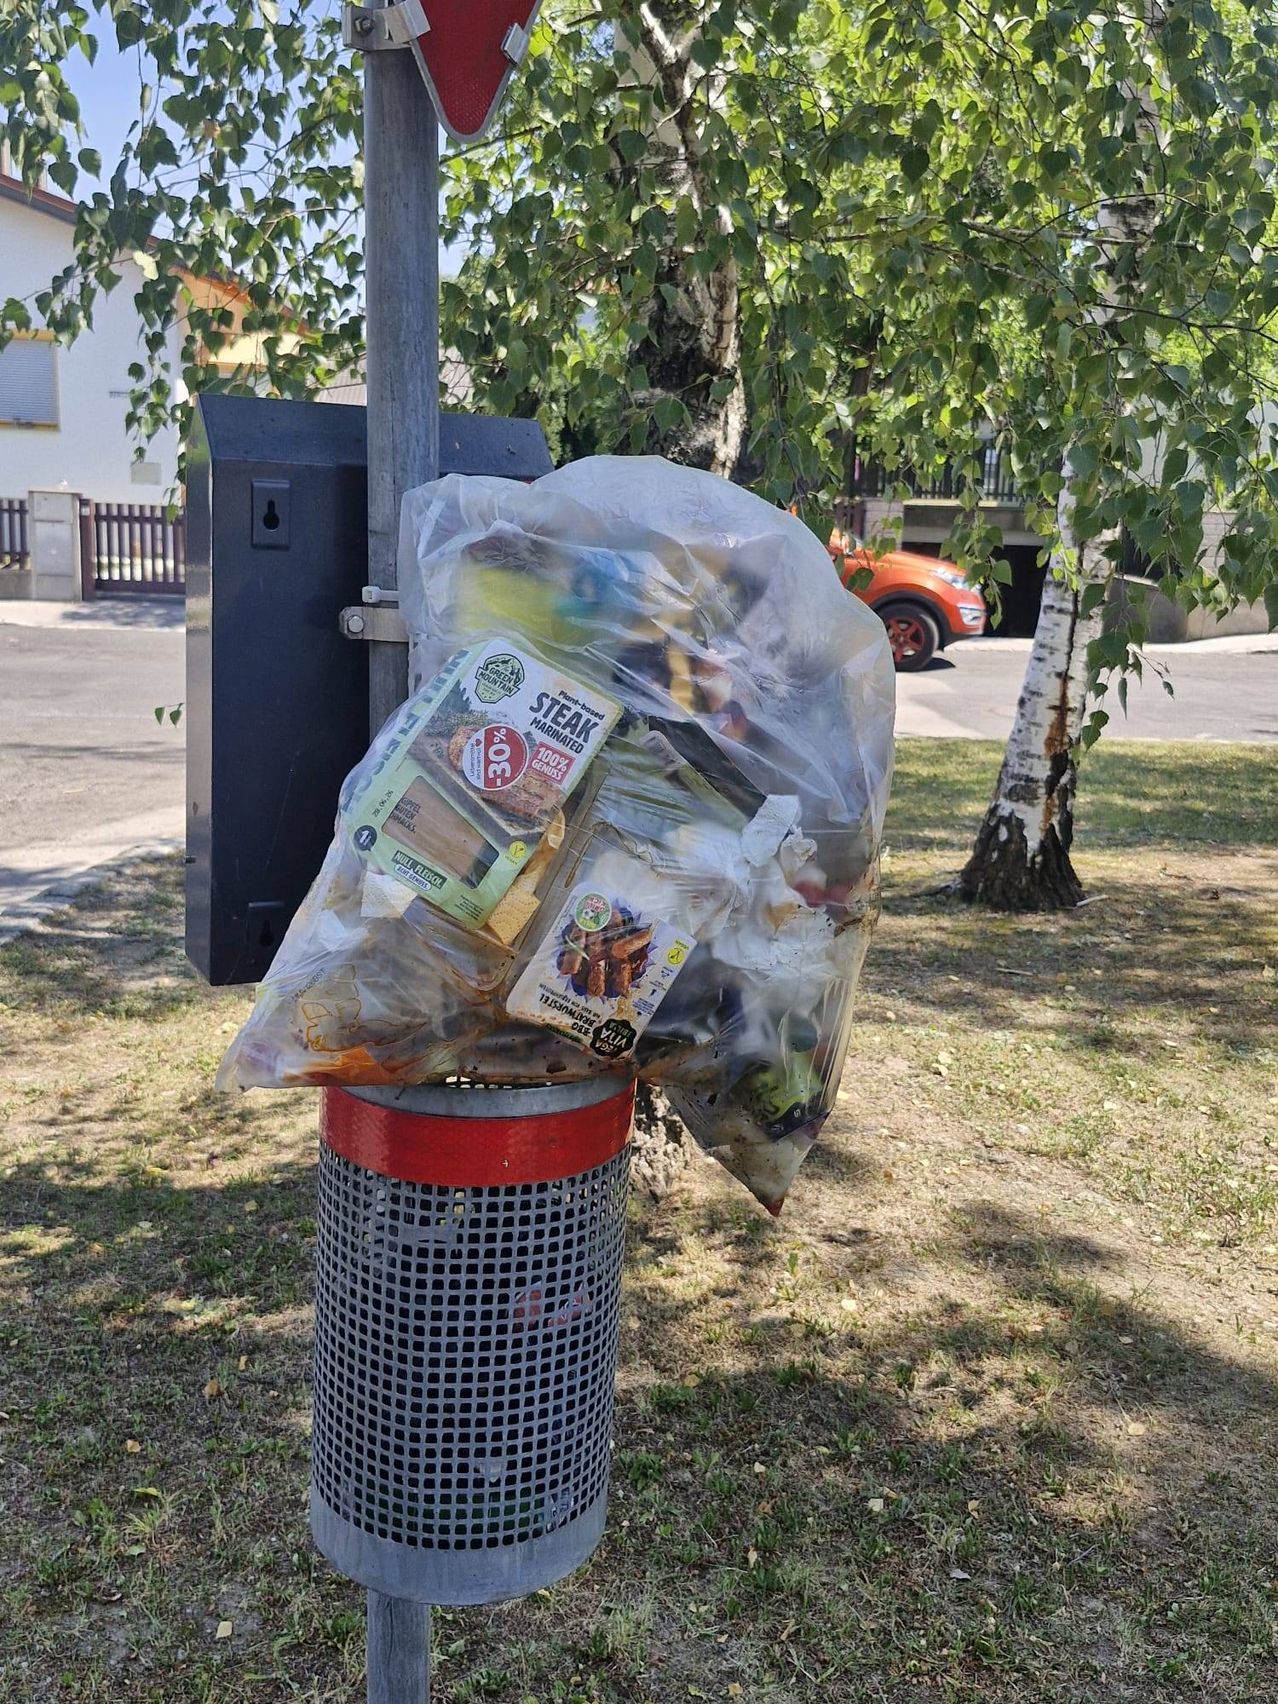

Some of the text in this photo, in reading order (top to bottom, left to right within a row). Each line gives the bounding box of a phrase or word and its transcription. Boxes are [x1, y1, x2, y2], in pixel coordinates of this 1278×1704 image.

[478, 672, 514, 694] MOUNTAIN
[489, 668, 513, 683] GREEN
[558, 690, 605, 720] Plant-based
[529, 692, 599, 743] STEAK
[530, 717, 584, 754] MARINATED
[488, 728, 511, 786] -30%
[538, 747, 570, 771] 100%
[532, 760, 562, 780] GENUSS
[394, 851, 443, 887] NULL FLEISCH.
[572, 1022, 591, 1036] BBQ
[600, 1027, 627, 1048] VITA
